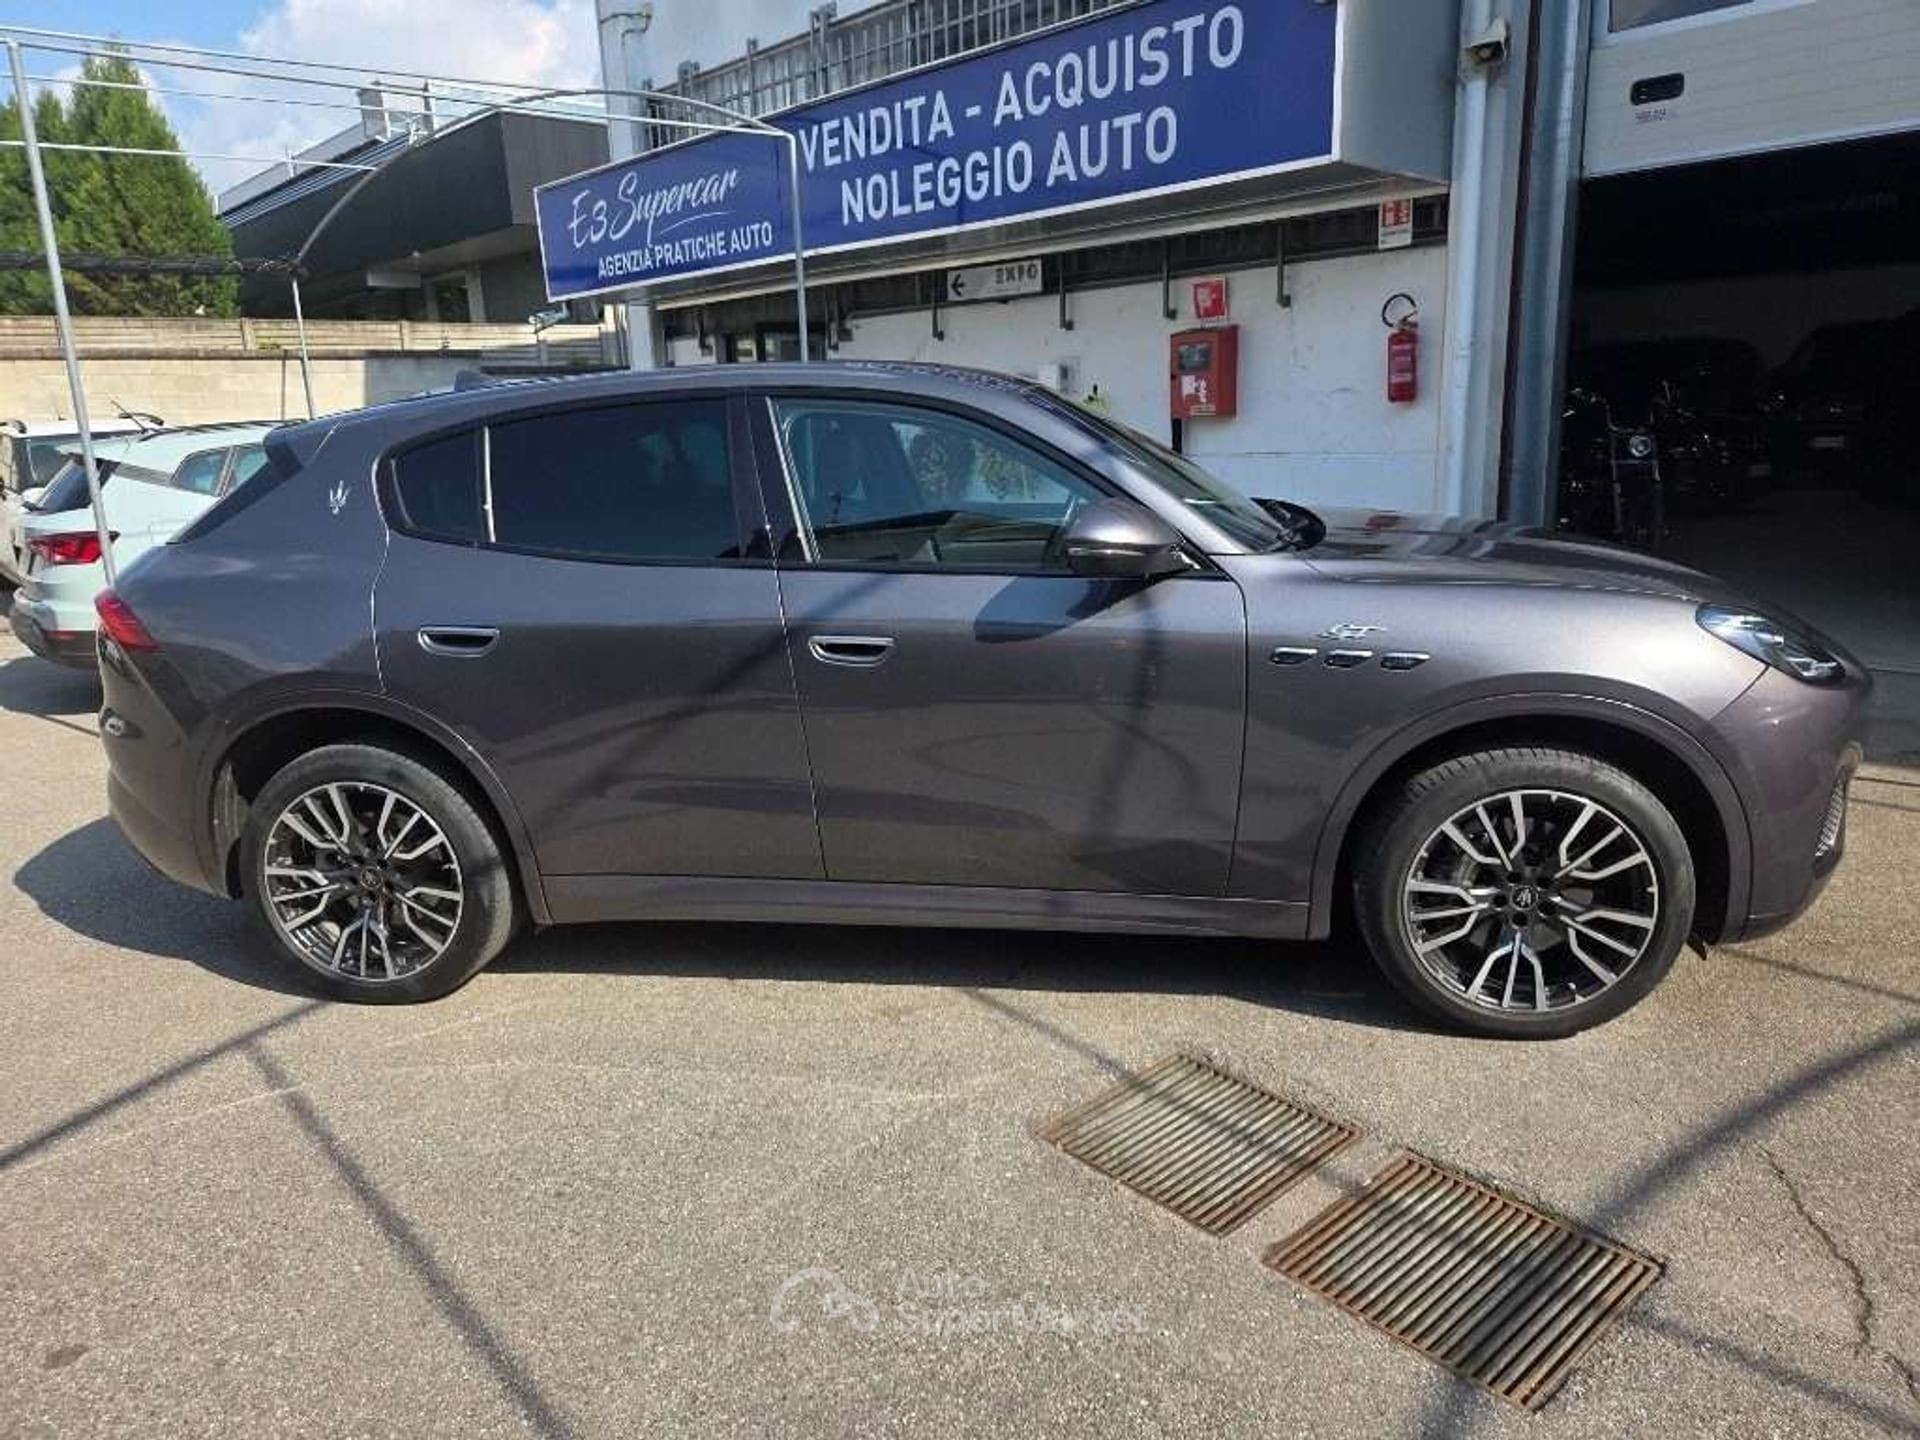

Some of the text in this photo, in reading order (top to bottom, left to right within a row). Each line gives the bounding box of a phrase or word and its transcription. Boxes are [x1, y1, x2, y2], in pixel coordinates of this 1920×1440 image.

[800, 90, 955, 172] VENDITA
[993, 5, 1245, 128] ACQUISTO
[568, 171, 739, 248] E3 Supercar
[841, 105, 1178, 226] NOLEGGIO AUTO
[598, 220, 774, 279] AGENZIA PRATICHE AUTO
